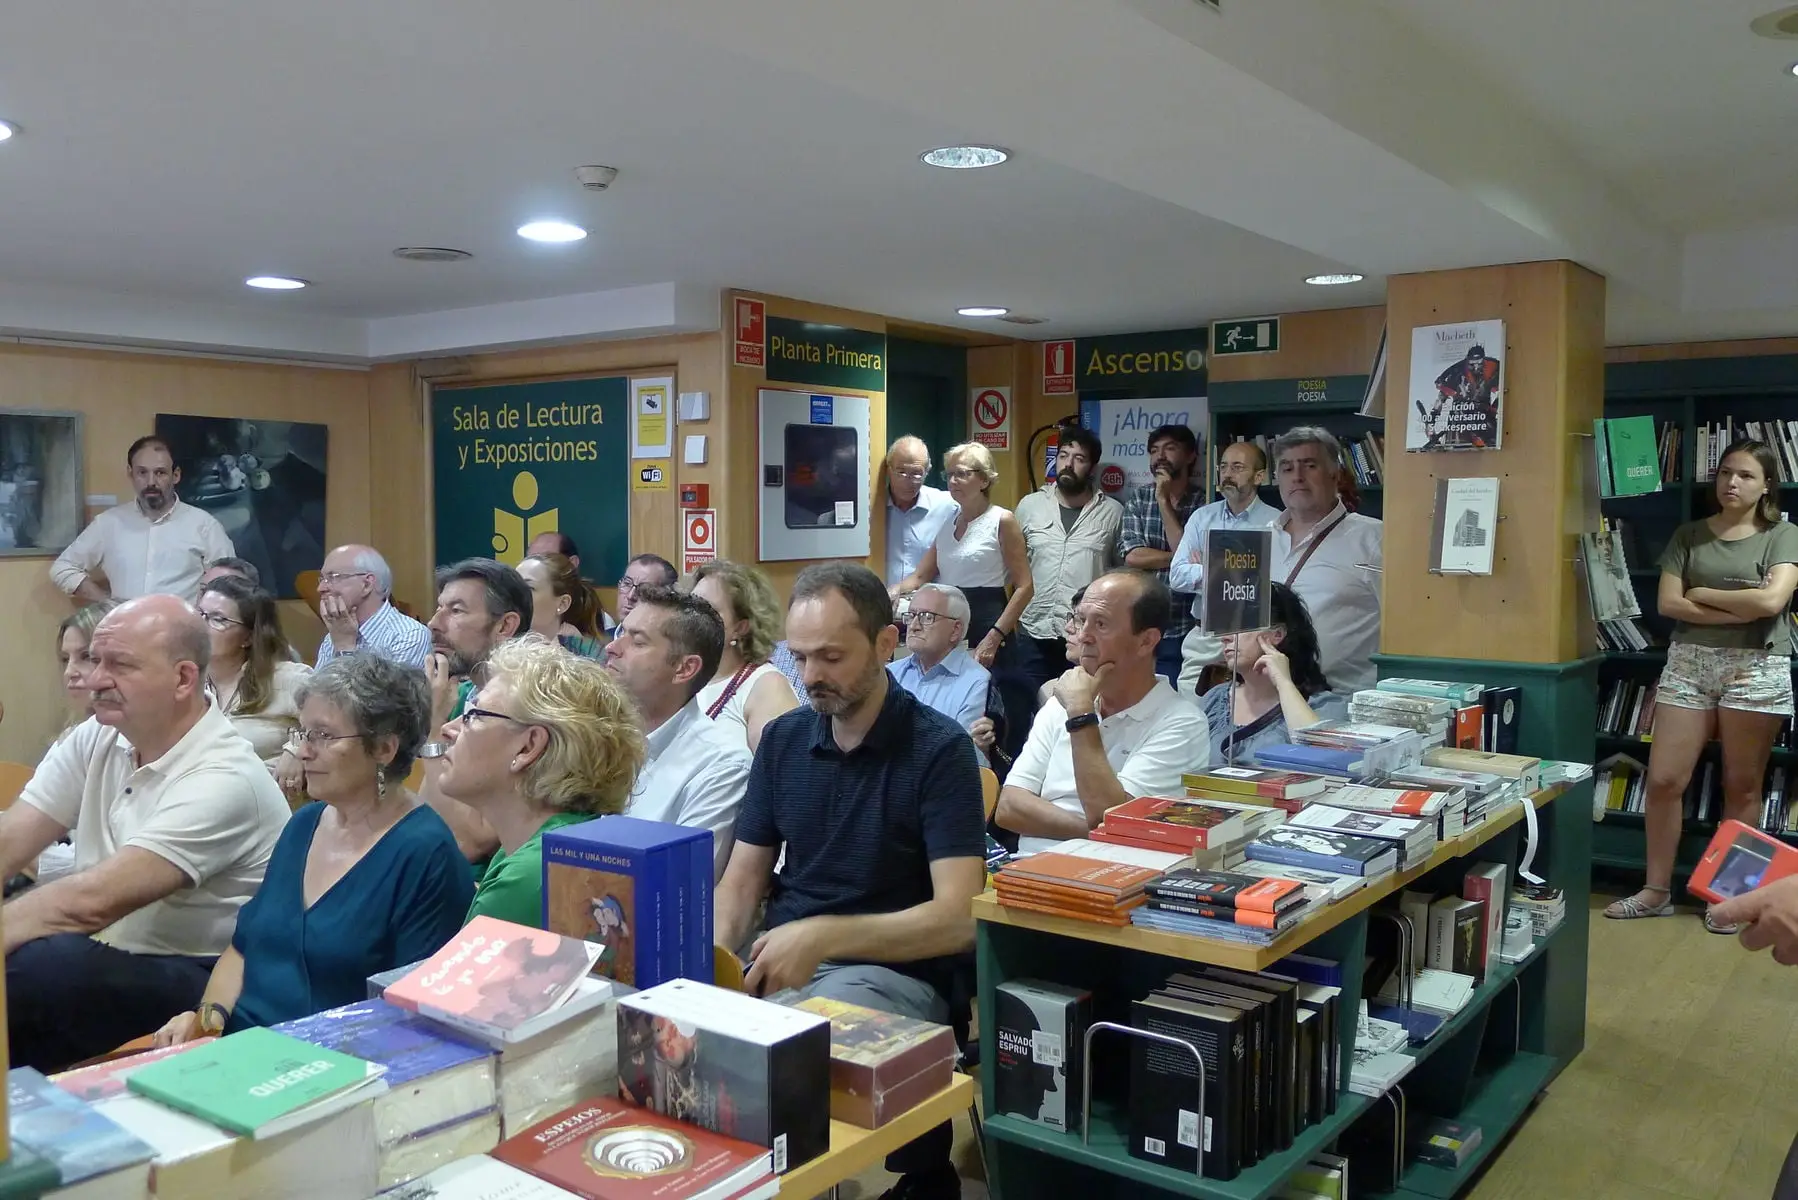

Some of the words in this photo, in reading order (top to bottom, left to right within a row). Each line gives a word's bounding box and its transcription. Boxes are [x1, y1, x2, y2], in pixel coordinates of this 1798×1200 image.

[1435, 329, 1476, 342] Macbeth
[771, 336, 820, 363] Planta
[826, 344, 881, 370] Primera
[453, 404, 489, 431] Sala
[496, 403, 519, 429] de
[526, 401, 603, 428] Lectura
[1114, 406, 1189, 436] ¡Ahora
[458, 445, 468, 470] y
[475, 438, 597, 469] Exposiciones
[1112, 439, 1146, 456] más
[1102, 472, 1123, 485] 48h
[1224, 549, 1256, 569] Poesia
[1223, 578, 1255, 601] Poesía
[550, 847, 563, 856] LAS
[565, 849, 577, 858] MIL
[579, 851, 584, 859] Y
[585, 852, 600, 862] UNA
[602, 855, 631, 867] NOCHES
[999, 1031, 1033, 1048] SALVADO
[999, 1041, 1028, 1056] ESPRIU
[533, 1106, 602, 1144] ESPEJOS
